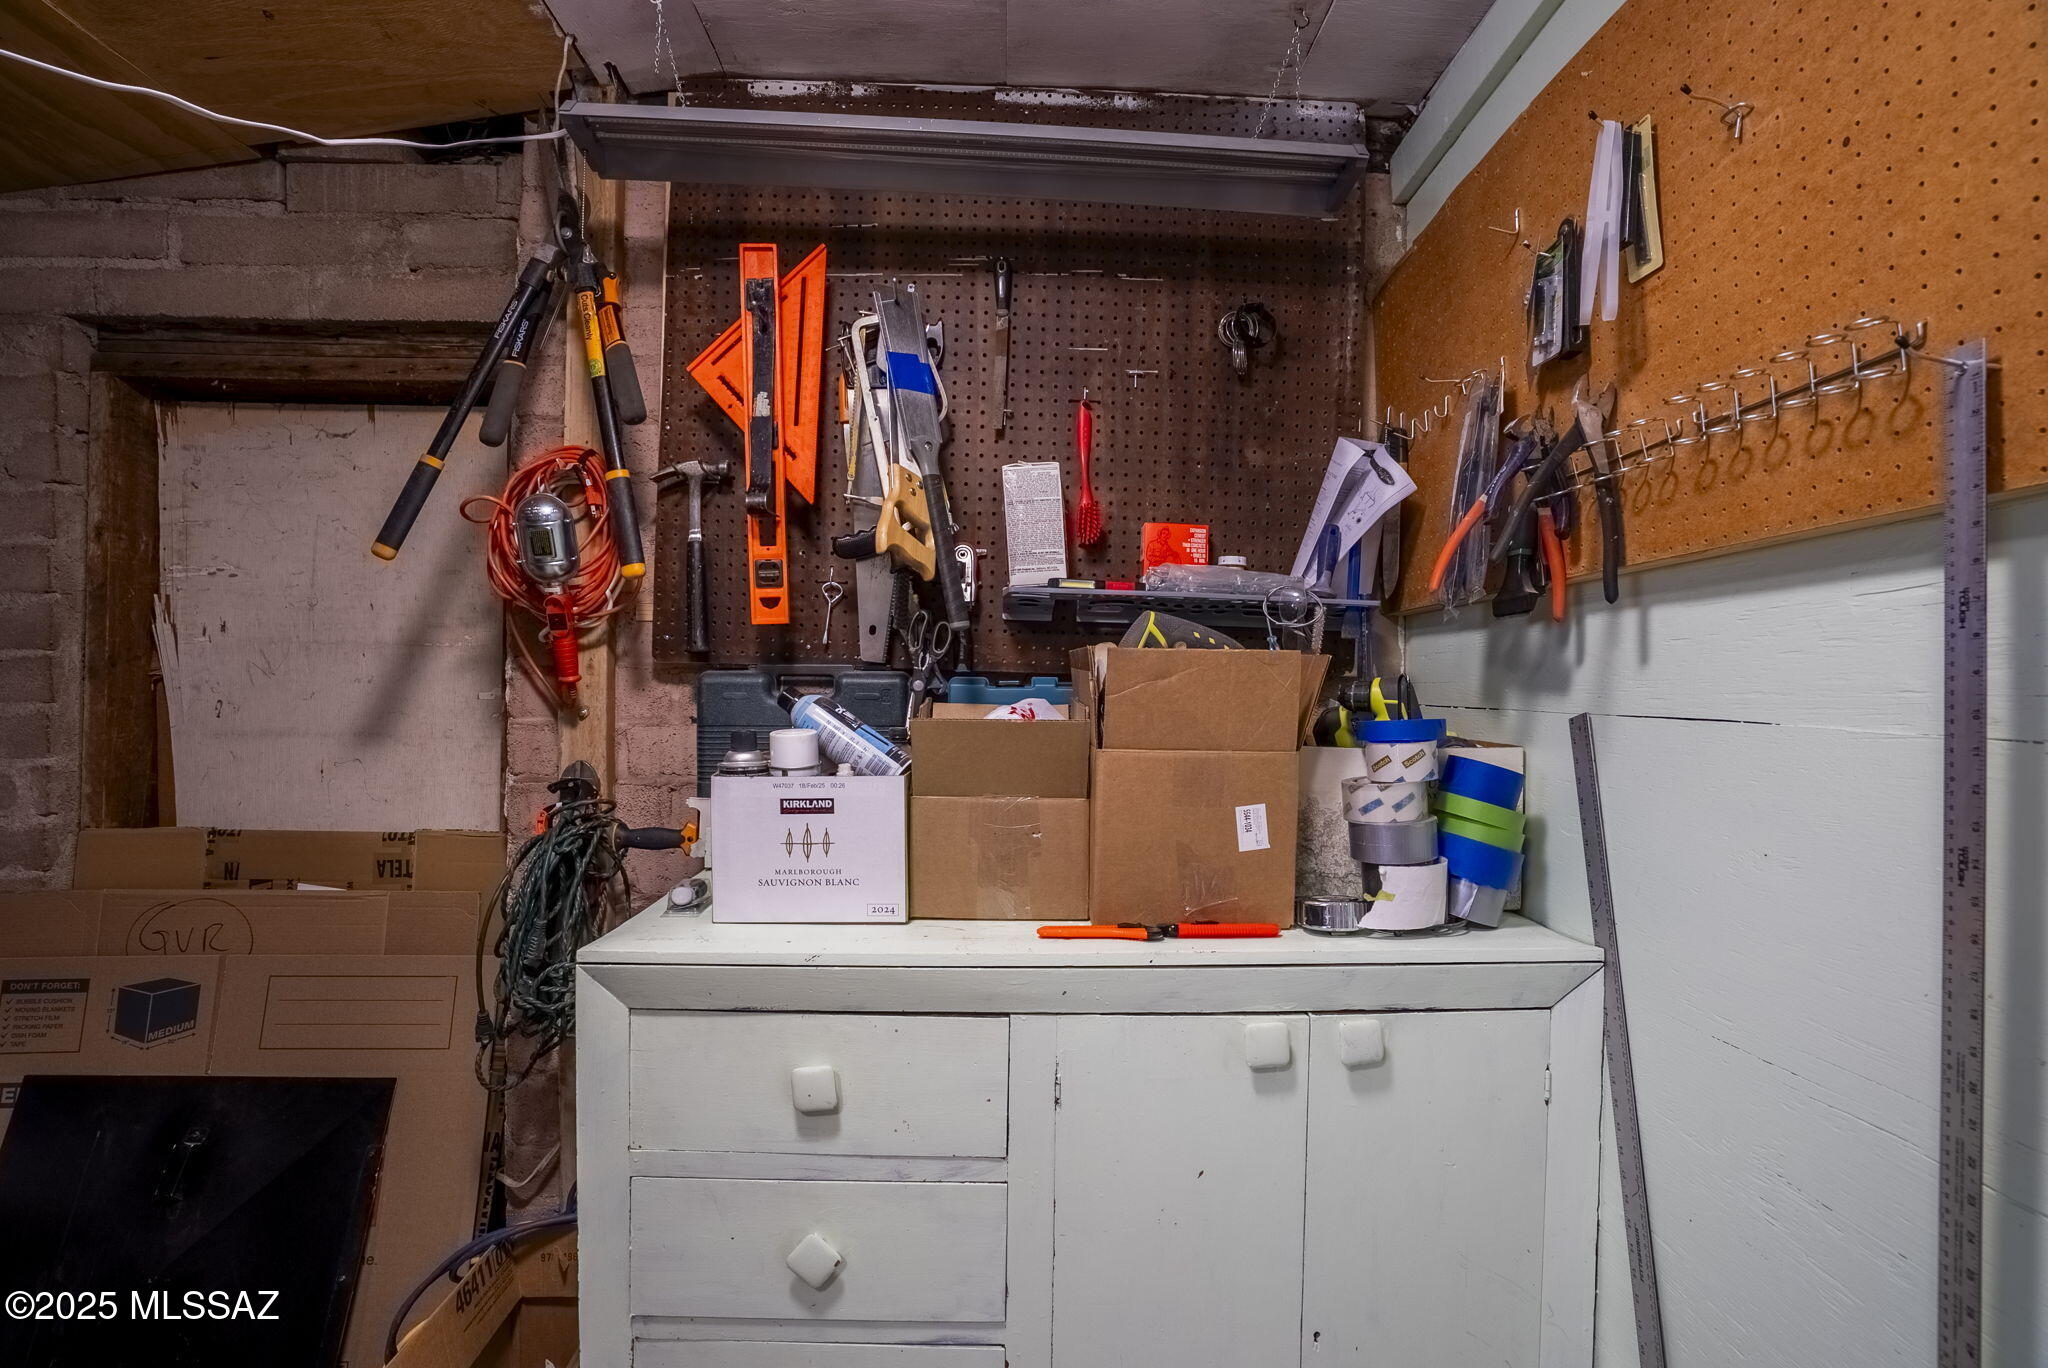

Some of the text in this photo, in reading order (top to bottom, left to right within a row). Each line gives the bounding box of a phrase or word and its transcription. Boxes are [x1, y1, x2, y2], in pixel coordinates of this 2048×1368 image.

[494, 300, 518, 339] FISKARS
[580, 294, 592, 341] Cuts Cleanly
[511, 319, 529, 357] FISKARS
[1372, 755, 1391, 771] Scotch
[1403, 750, 1425, 768] Scotch
[783, 800, 833, 808] KIRKLAND
[758, 878, 860, 887] SAUVIGNON BLANC
[871, 906, 896, 915] 2024
[10, 981, 81, 991] DON'T FORGET:
[149, 1019, 195, 1040] MEDIUM
